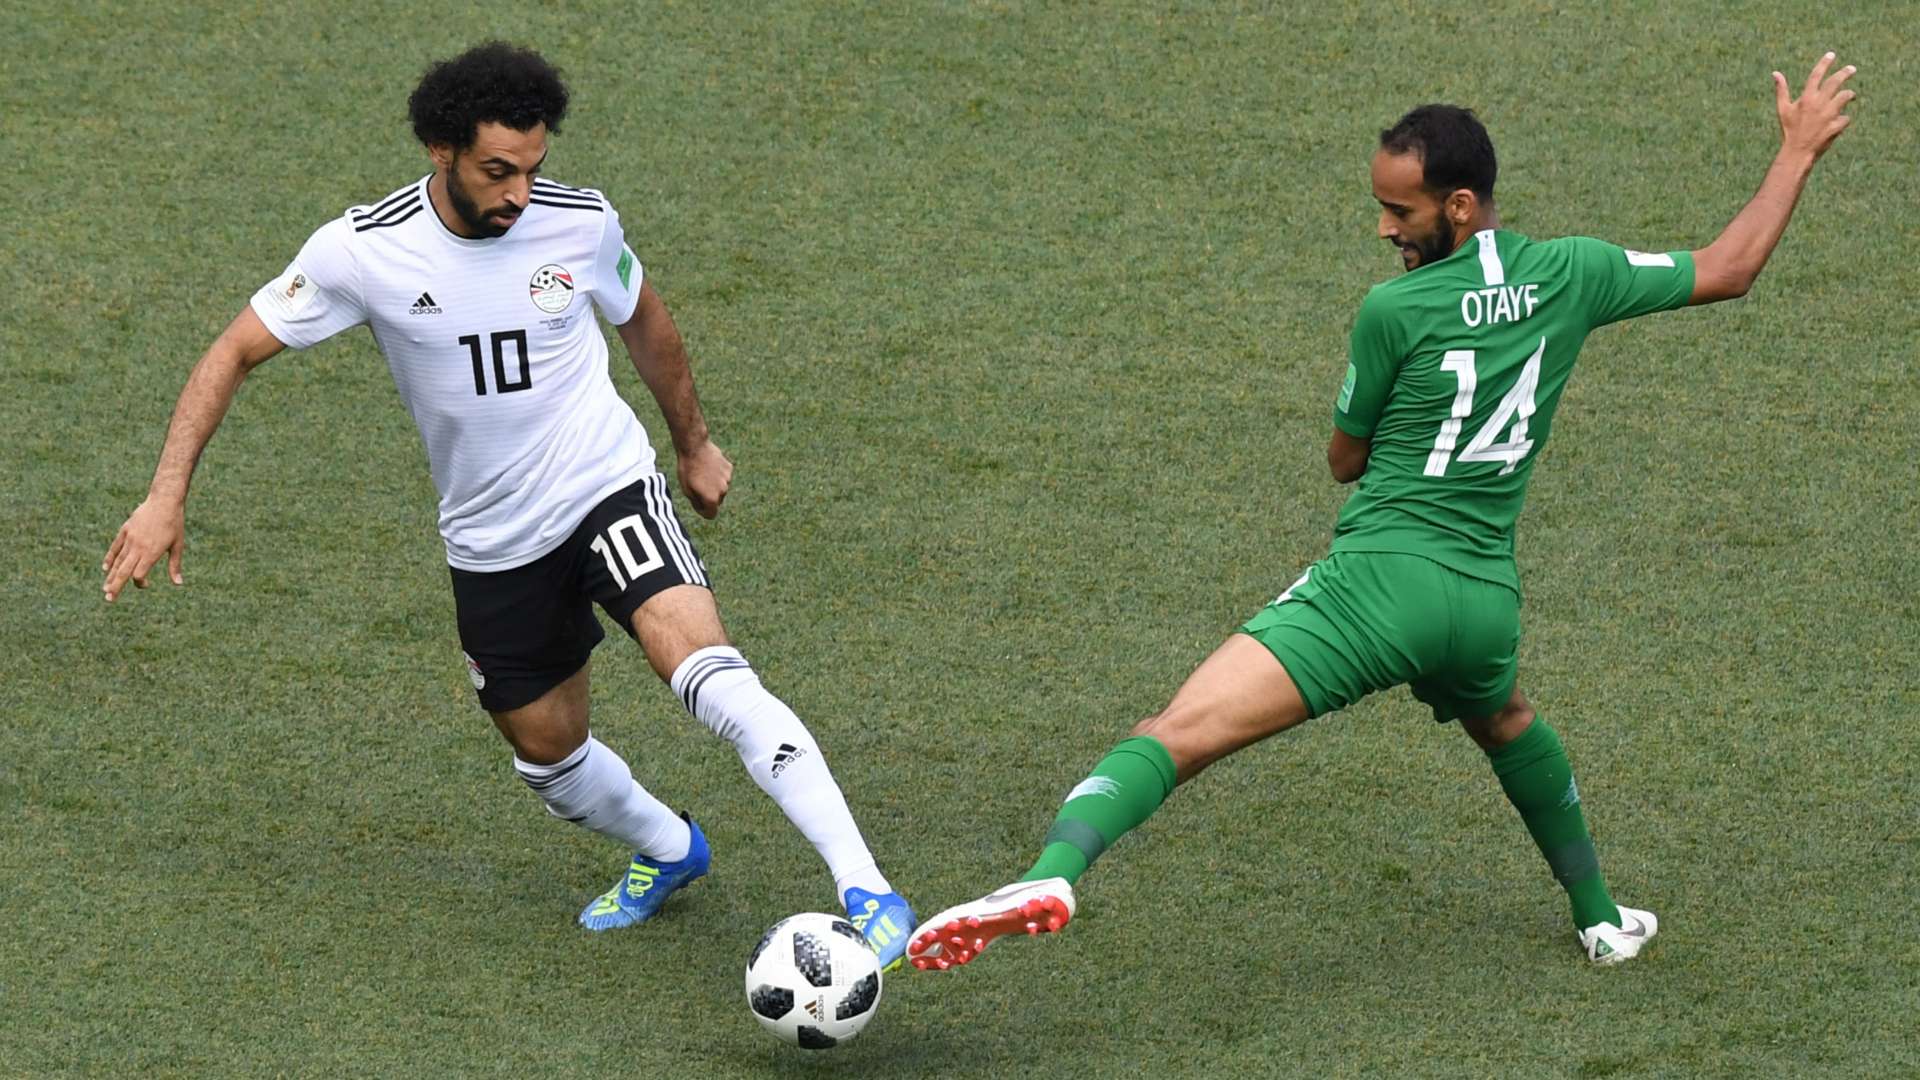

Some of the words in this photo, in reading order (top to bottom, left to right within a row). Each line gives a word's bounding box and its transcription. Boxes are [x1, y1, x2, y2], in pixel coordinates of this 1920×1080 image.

[409, 306, 443, 316] adidas
[1461, 284, 1540, 328] OTAYF
[459, 330, 532, 395] 10
[1422, 335, 1545, 477] 14
[590, 513, 665, 591] 10
[772, 748, 807, 779] adidas
